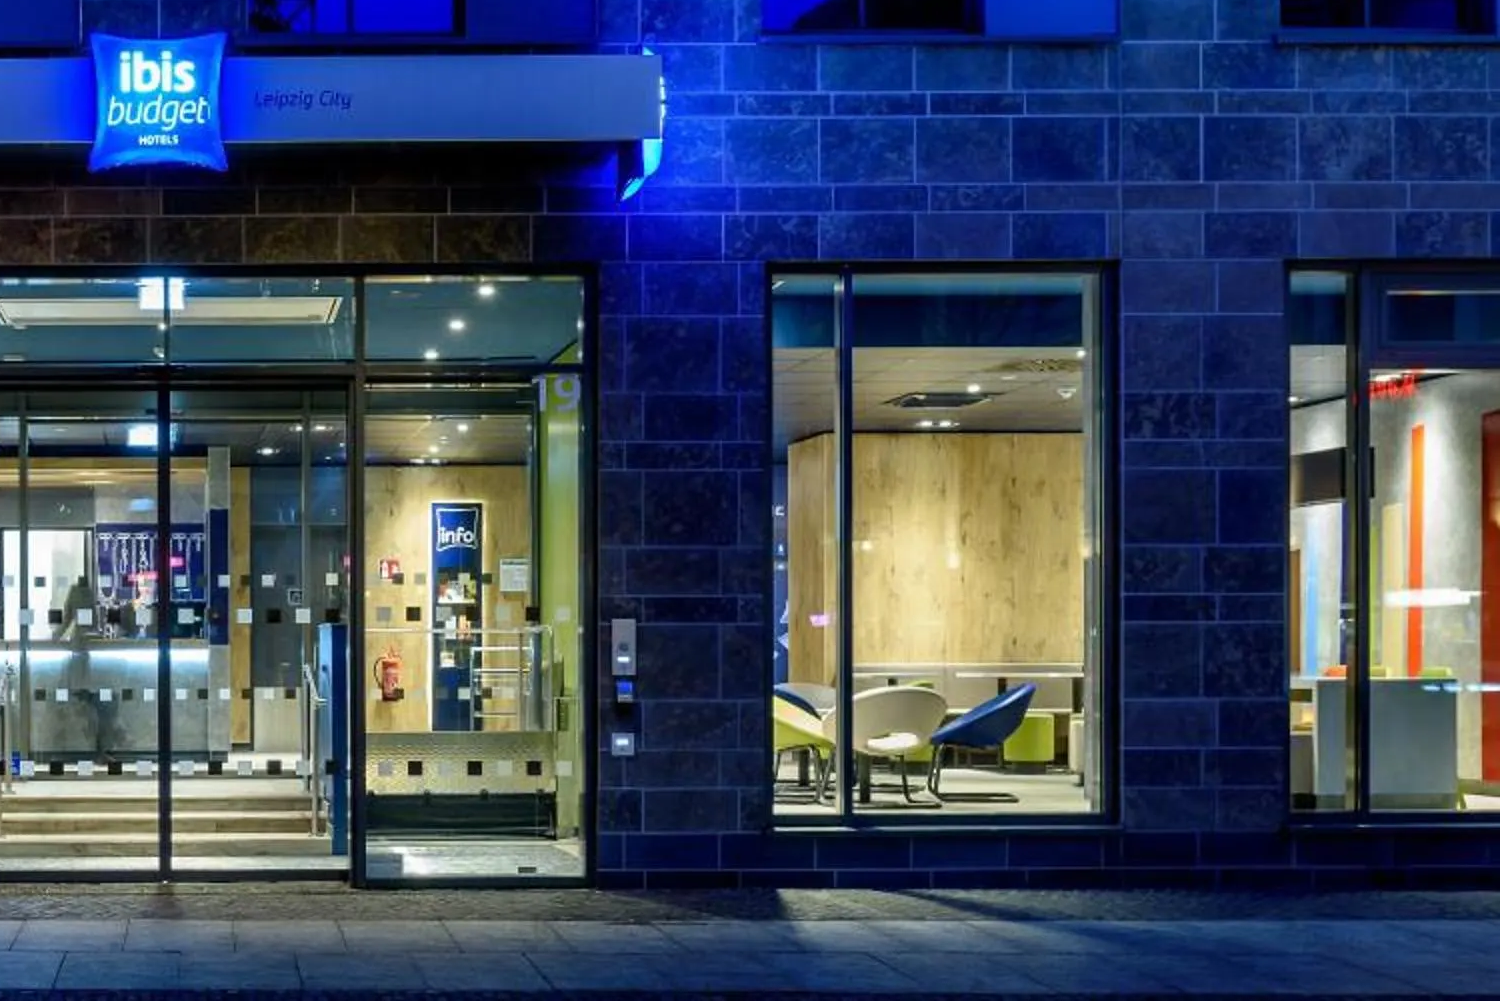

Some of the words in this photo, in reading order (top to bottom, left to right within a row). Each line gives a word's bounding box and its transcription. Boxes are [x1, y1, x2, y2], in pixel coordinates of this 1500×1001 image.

[119, 50, 196, 94] ibis
[108, 95, 211, 131] budget
[254, 90, 313, 111] Leipzig
[319, 90, 352, 111] City
[139, 135, 179, 146] HOTELS
[532, 374, 581, 412] 19
